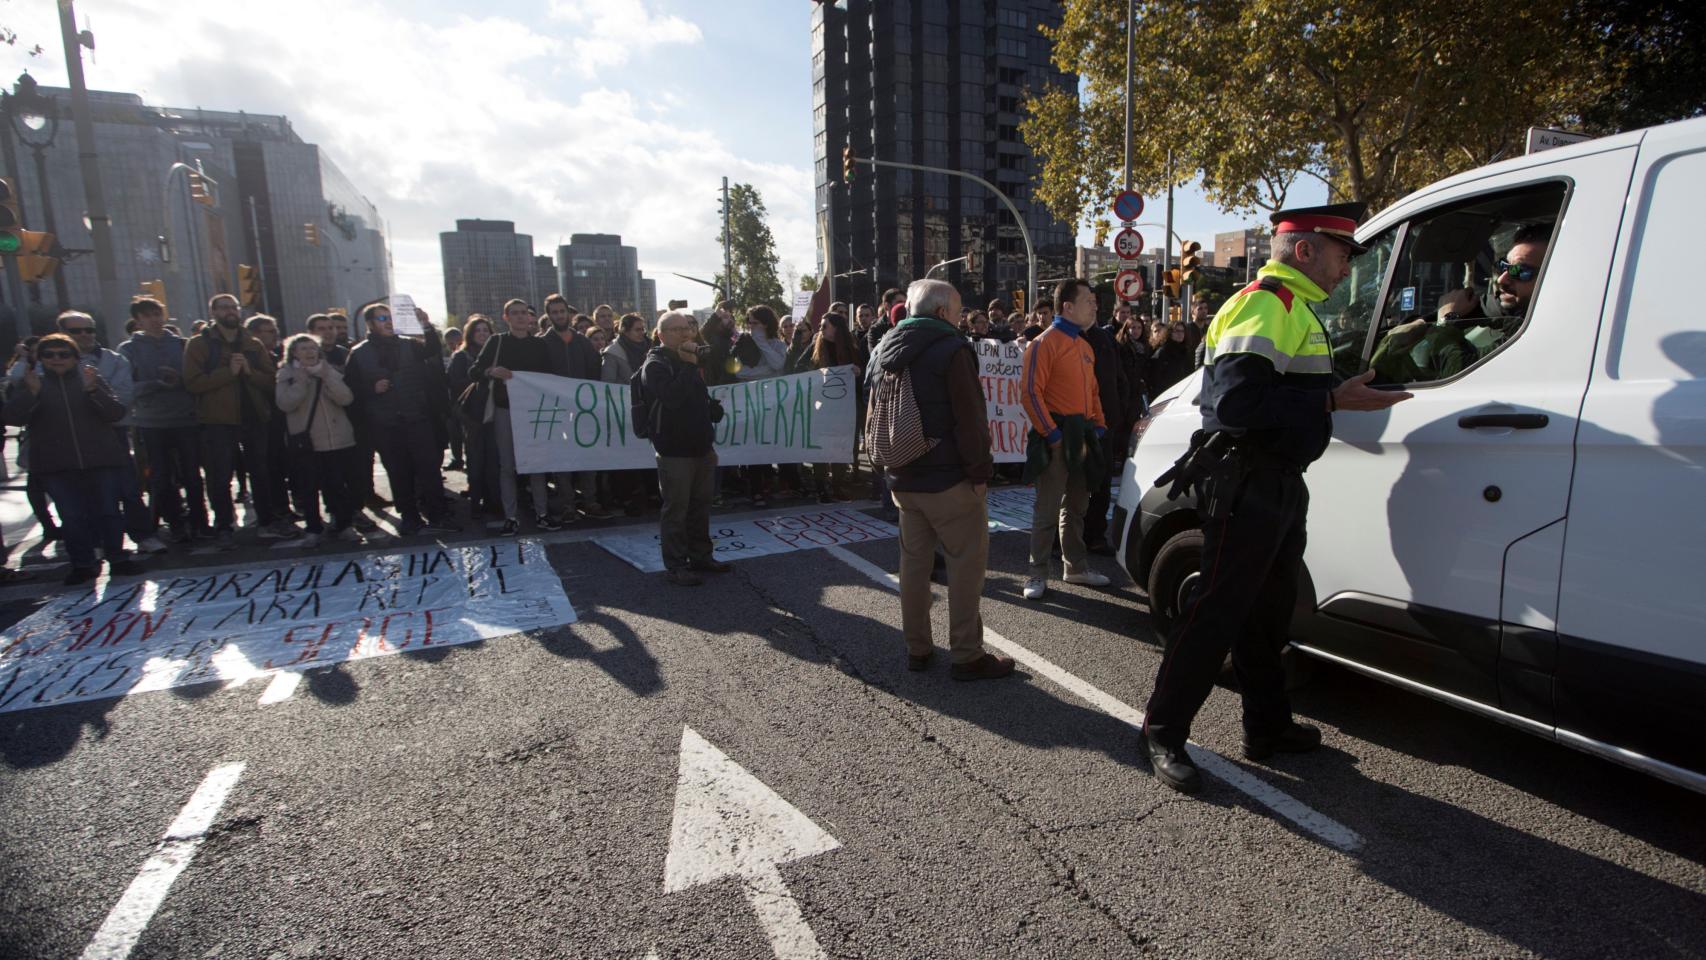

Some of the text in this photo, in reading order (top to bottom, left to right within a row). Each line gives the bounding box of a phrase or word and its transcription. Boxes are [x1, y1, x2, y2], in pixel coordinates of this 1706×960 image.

[1004, 346, 1019, 359] LES
[702, 377, 822, 450] GENERAL
[995, 405, 1004, 417] la
[157, 560, 365, 605] PARAULA
[213, 591, 321, 630] ARA
